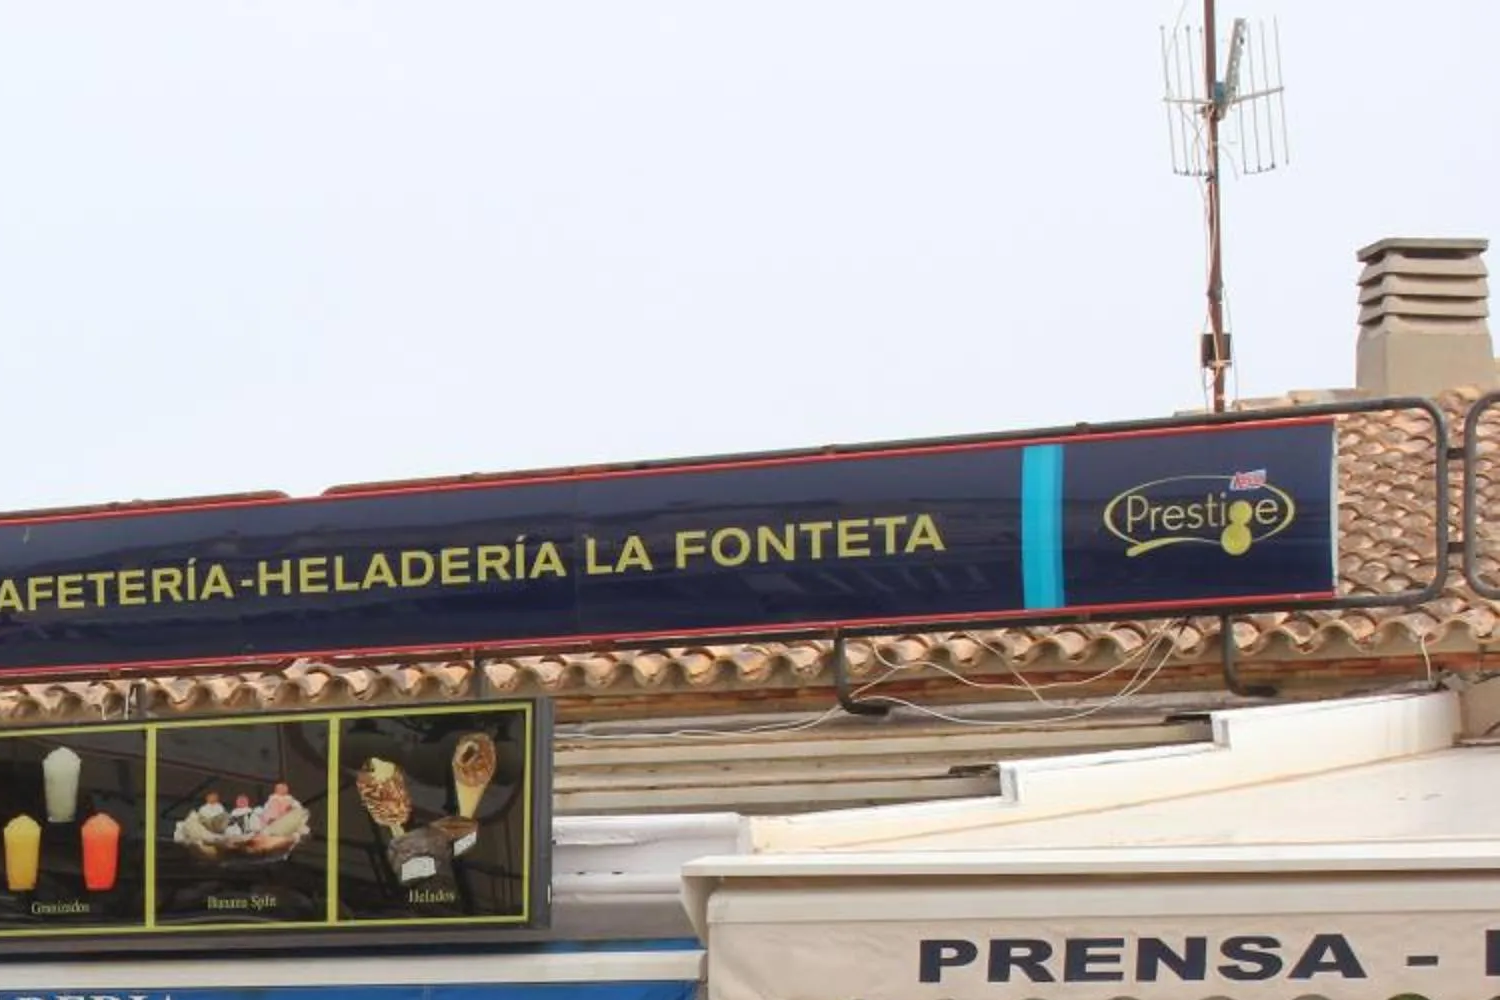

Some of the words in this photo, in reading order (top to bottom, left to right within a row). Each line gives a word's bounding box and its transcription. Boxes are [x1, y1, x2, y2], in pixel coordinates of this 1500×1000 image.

[585, 536, 652, 574] LA
[674, 514, 944, 567] FONTETA
[919, 934, 1367, 983] PRENSA
